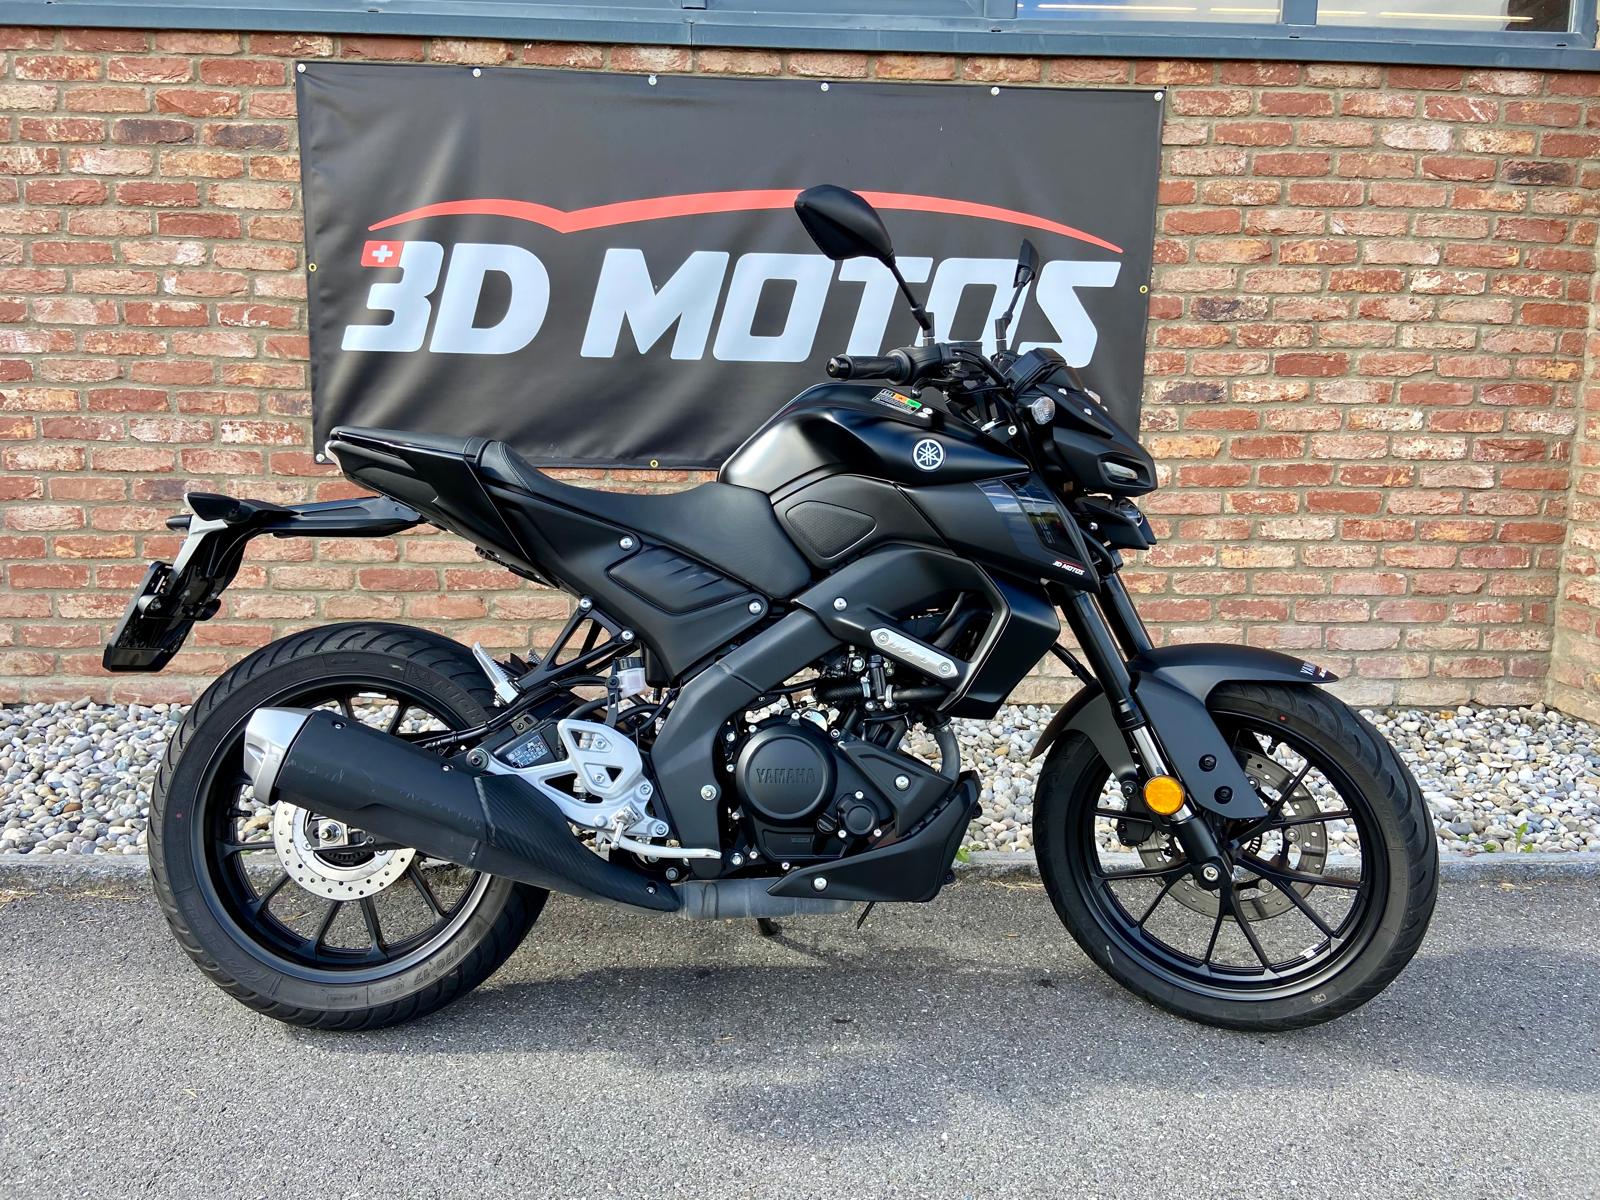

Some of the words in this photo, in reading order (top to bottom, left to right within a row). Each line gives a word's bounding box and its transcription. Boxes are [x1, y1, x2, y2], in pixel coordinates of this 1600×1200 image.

[340, 240, 550, 355] 3D
[580, 247, 1122, 369] MOTOS
[1062, 563, 1085, 575] MOTOS
[756, 768, 816, 784] YAMAHA
